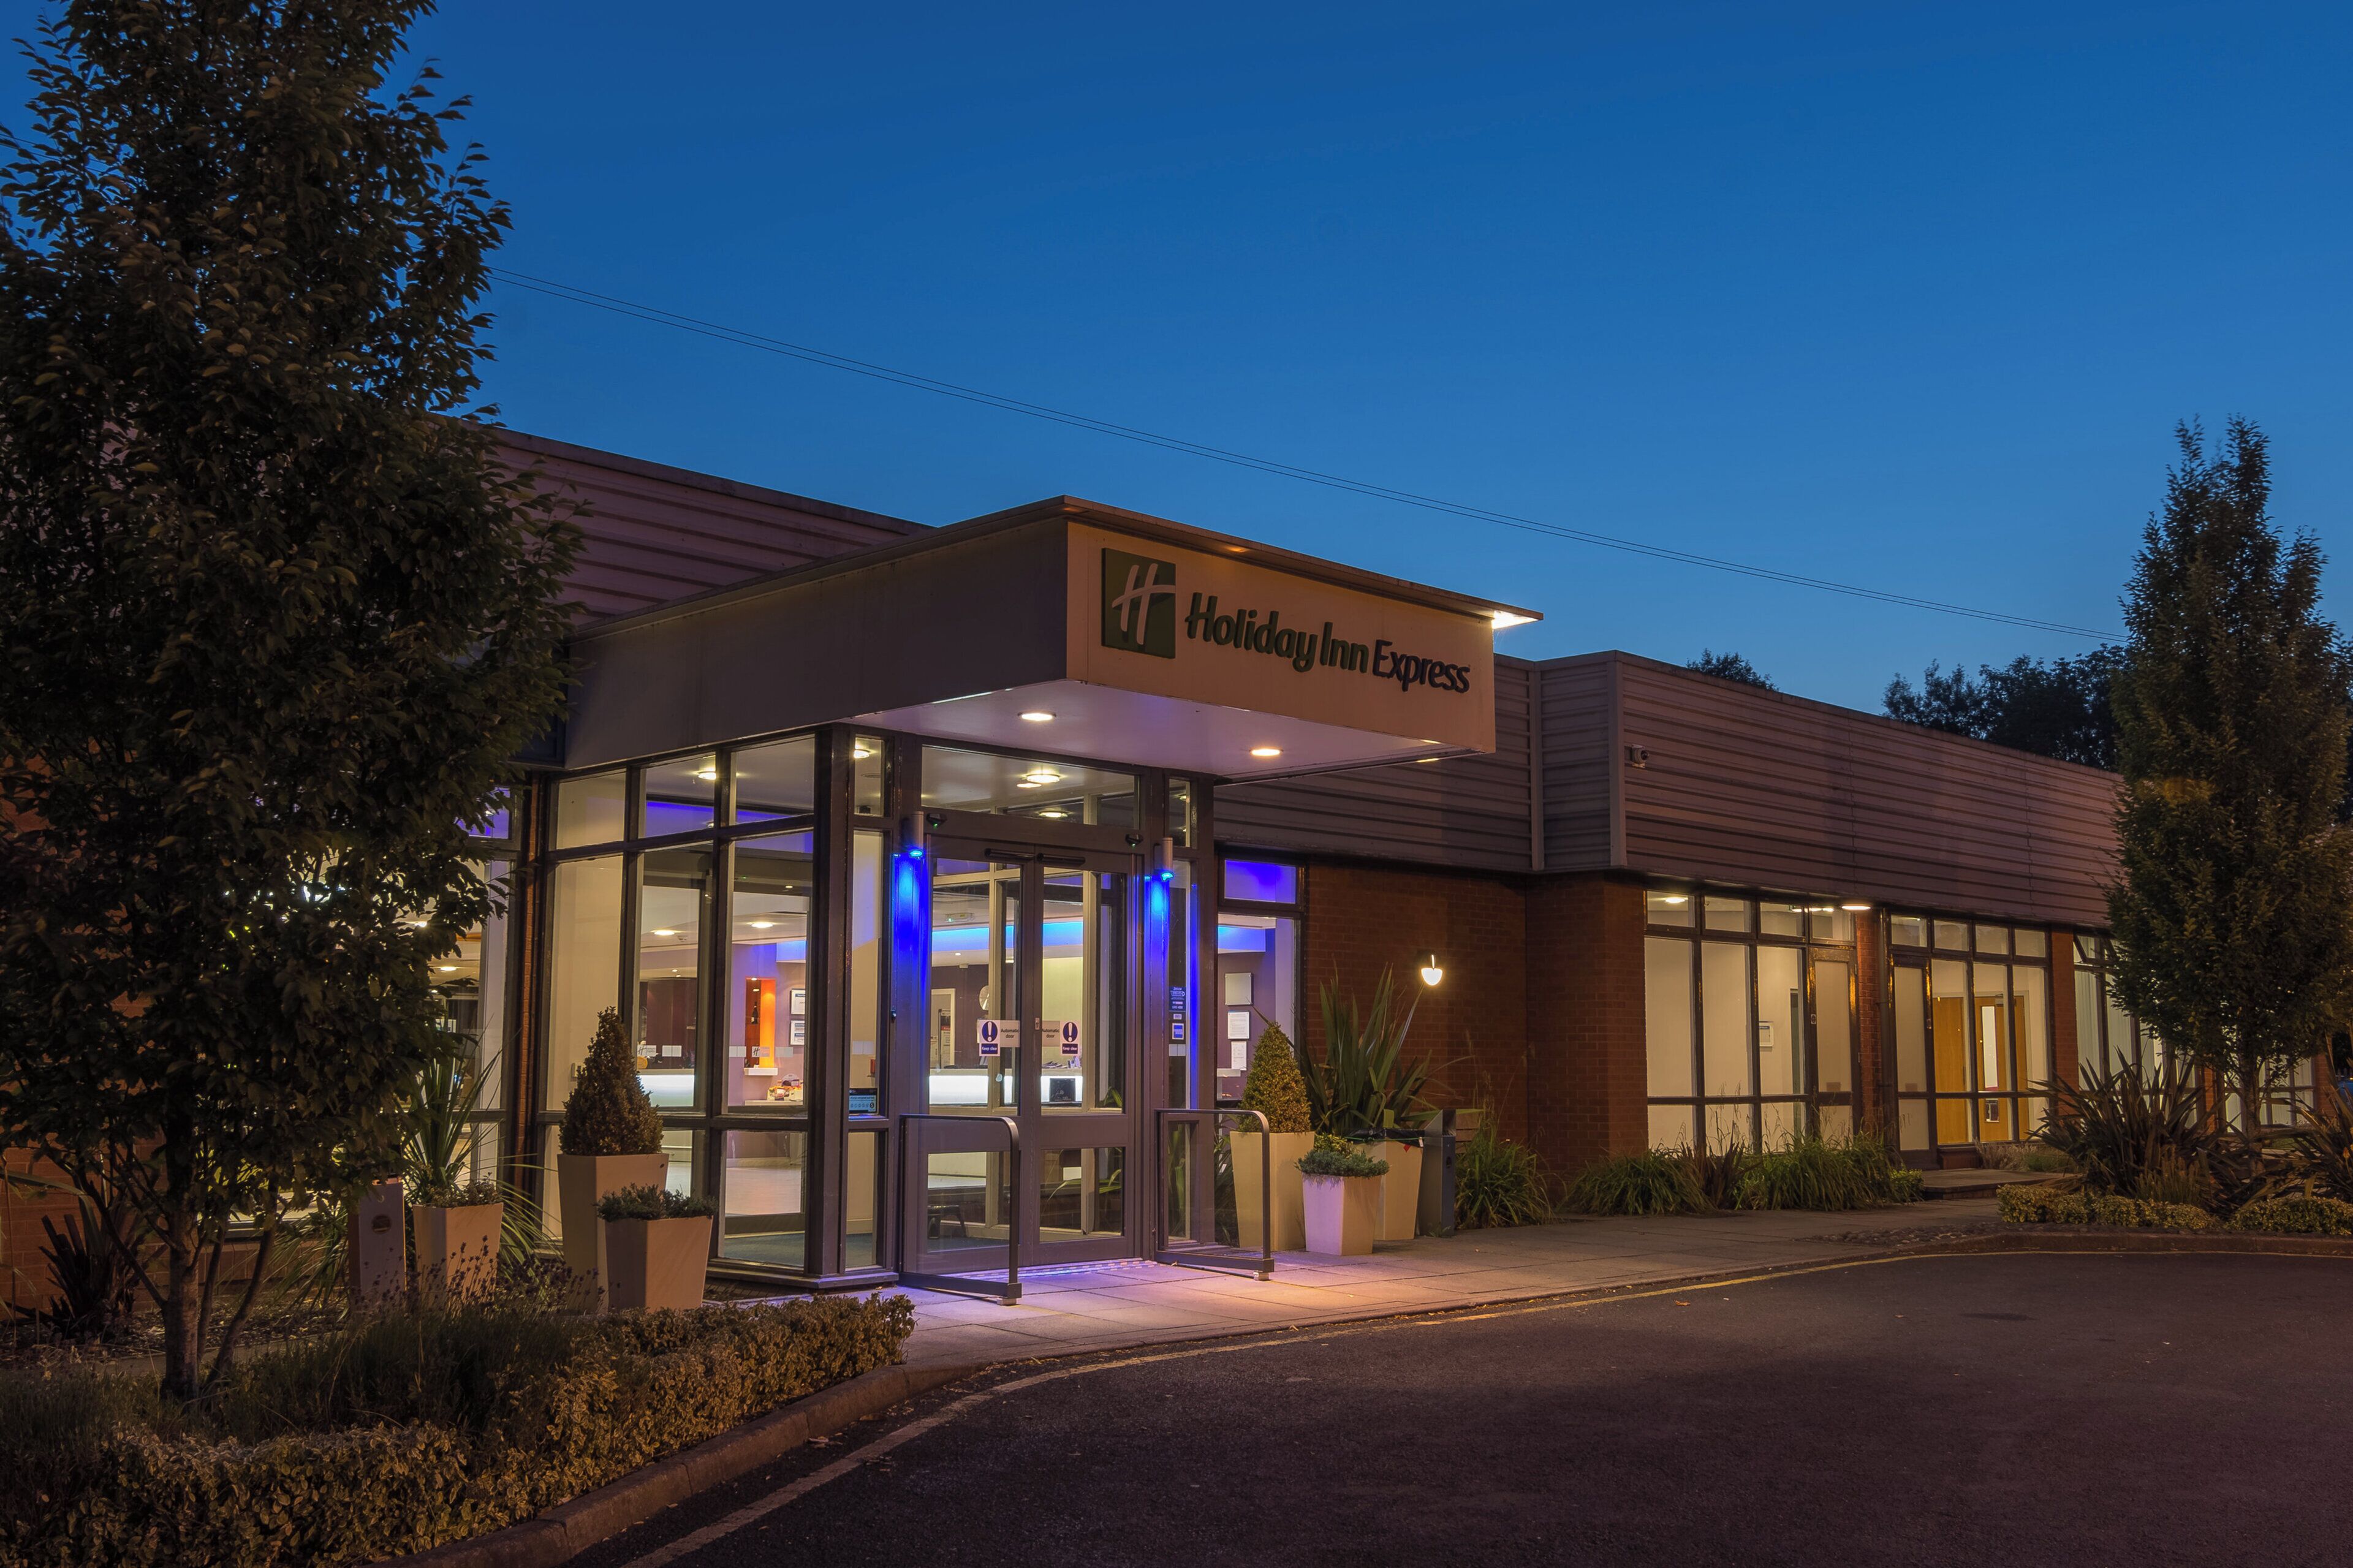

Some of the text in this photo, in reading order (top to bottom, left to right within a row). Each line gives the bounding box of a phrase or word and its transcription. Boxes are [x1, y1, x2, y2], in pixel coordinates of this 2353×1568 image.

[1184, 591, 1471, 694] Holiday Inn Express
